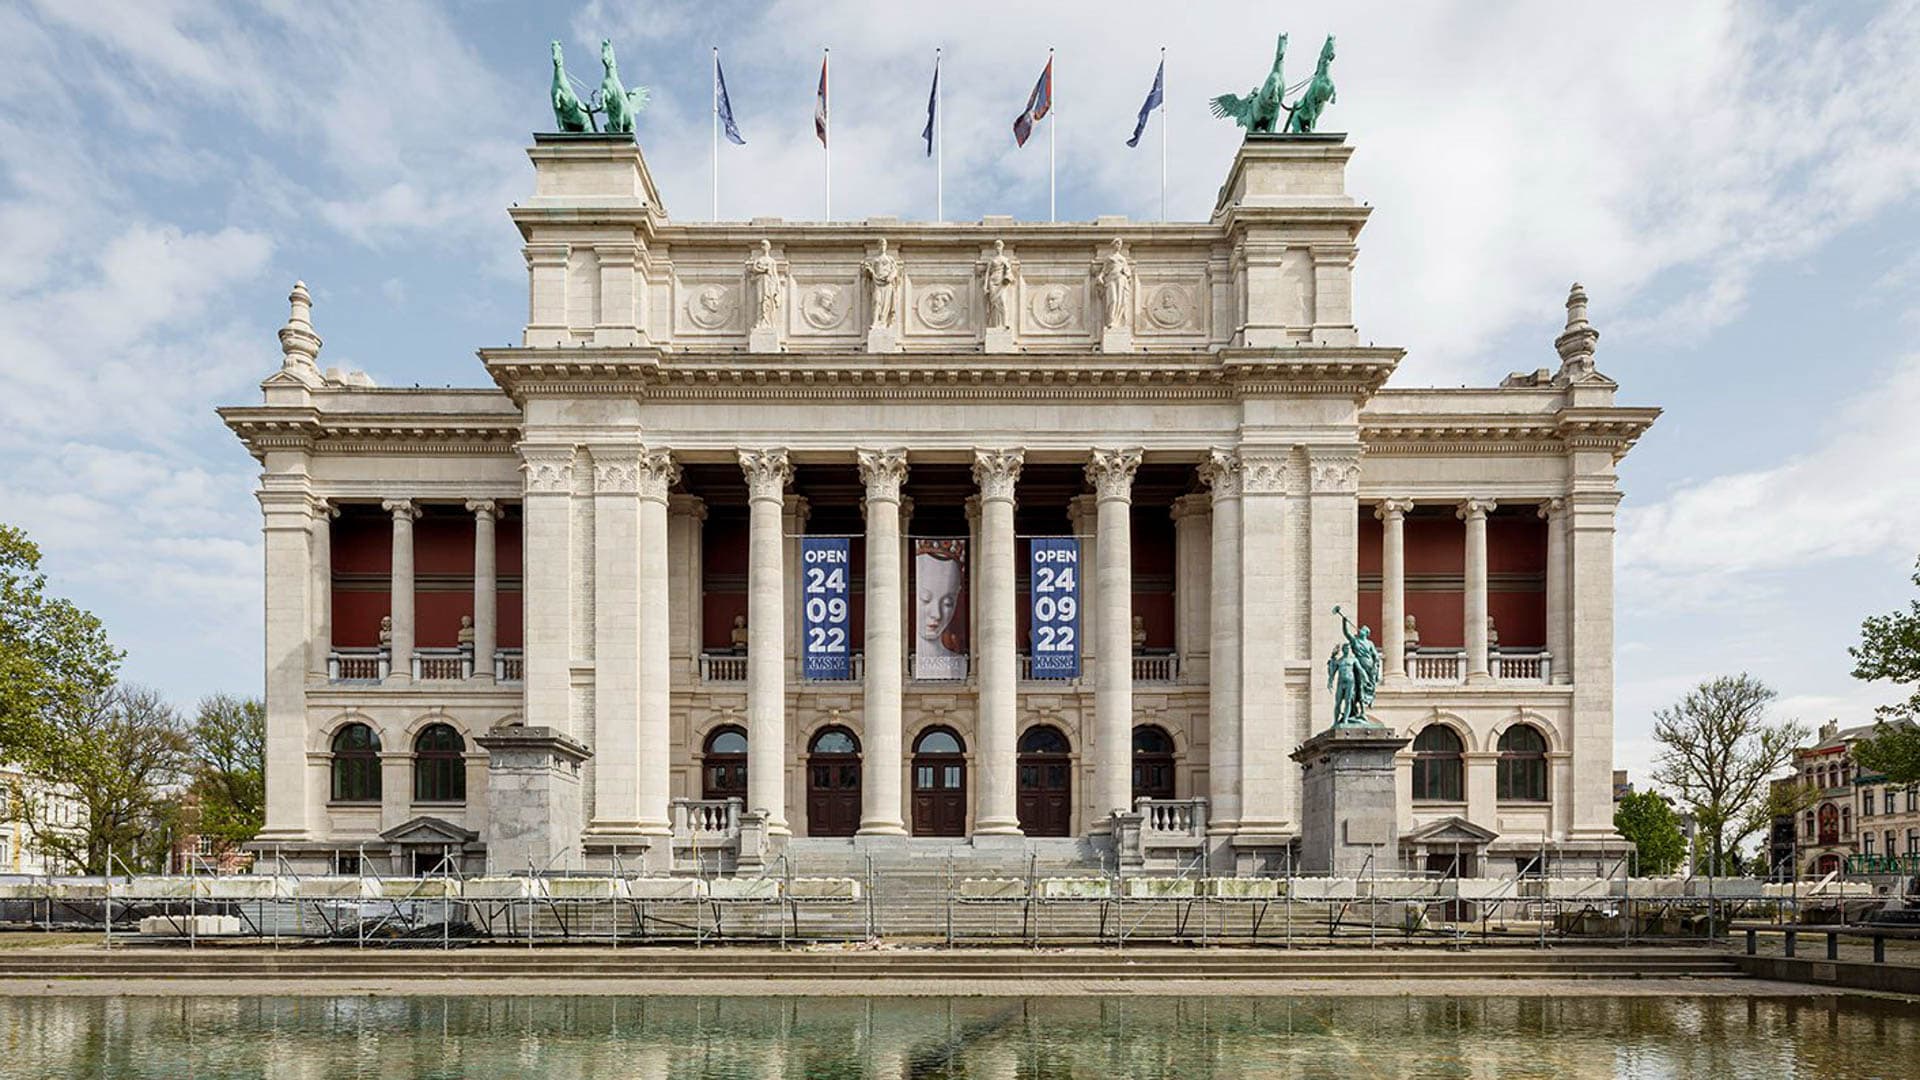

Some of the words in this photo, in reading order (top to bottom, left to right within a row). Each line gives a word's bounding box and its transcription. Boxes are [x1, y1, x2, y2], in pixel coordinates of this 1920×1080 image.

[805, 550, 847, 563] OPEN
[1035, 550, 1077, 563] OPEN
[807, 568, 846, 593] 24
[1036, 567, 1075, 592] 24
[807, 597, 847, 623] 09
[1035, 596, 1077, 622] 09
[808, 627, 845, 652] 22
[1037, 626, 1074, 651] 22
